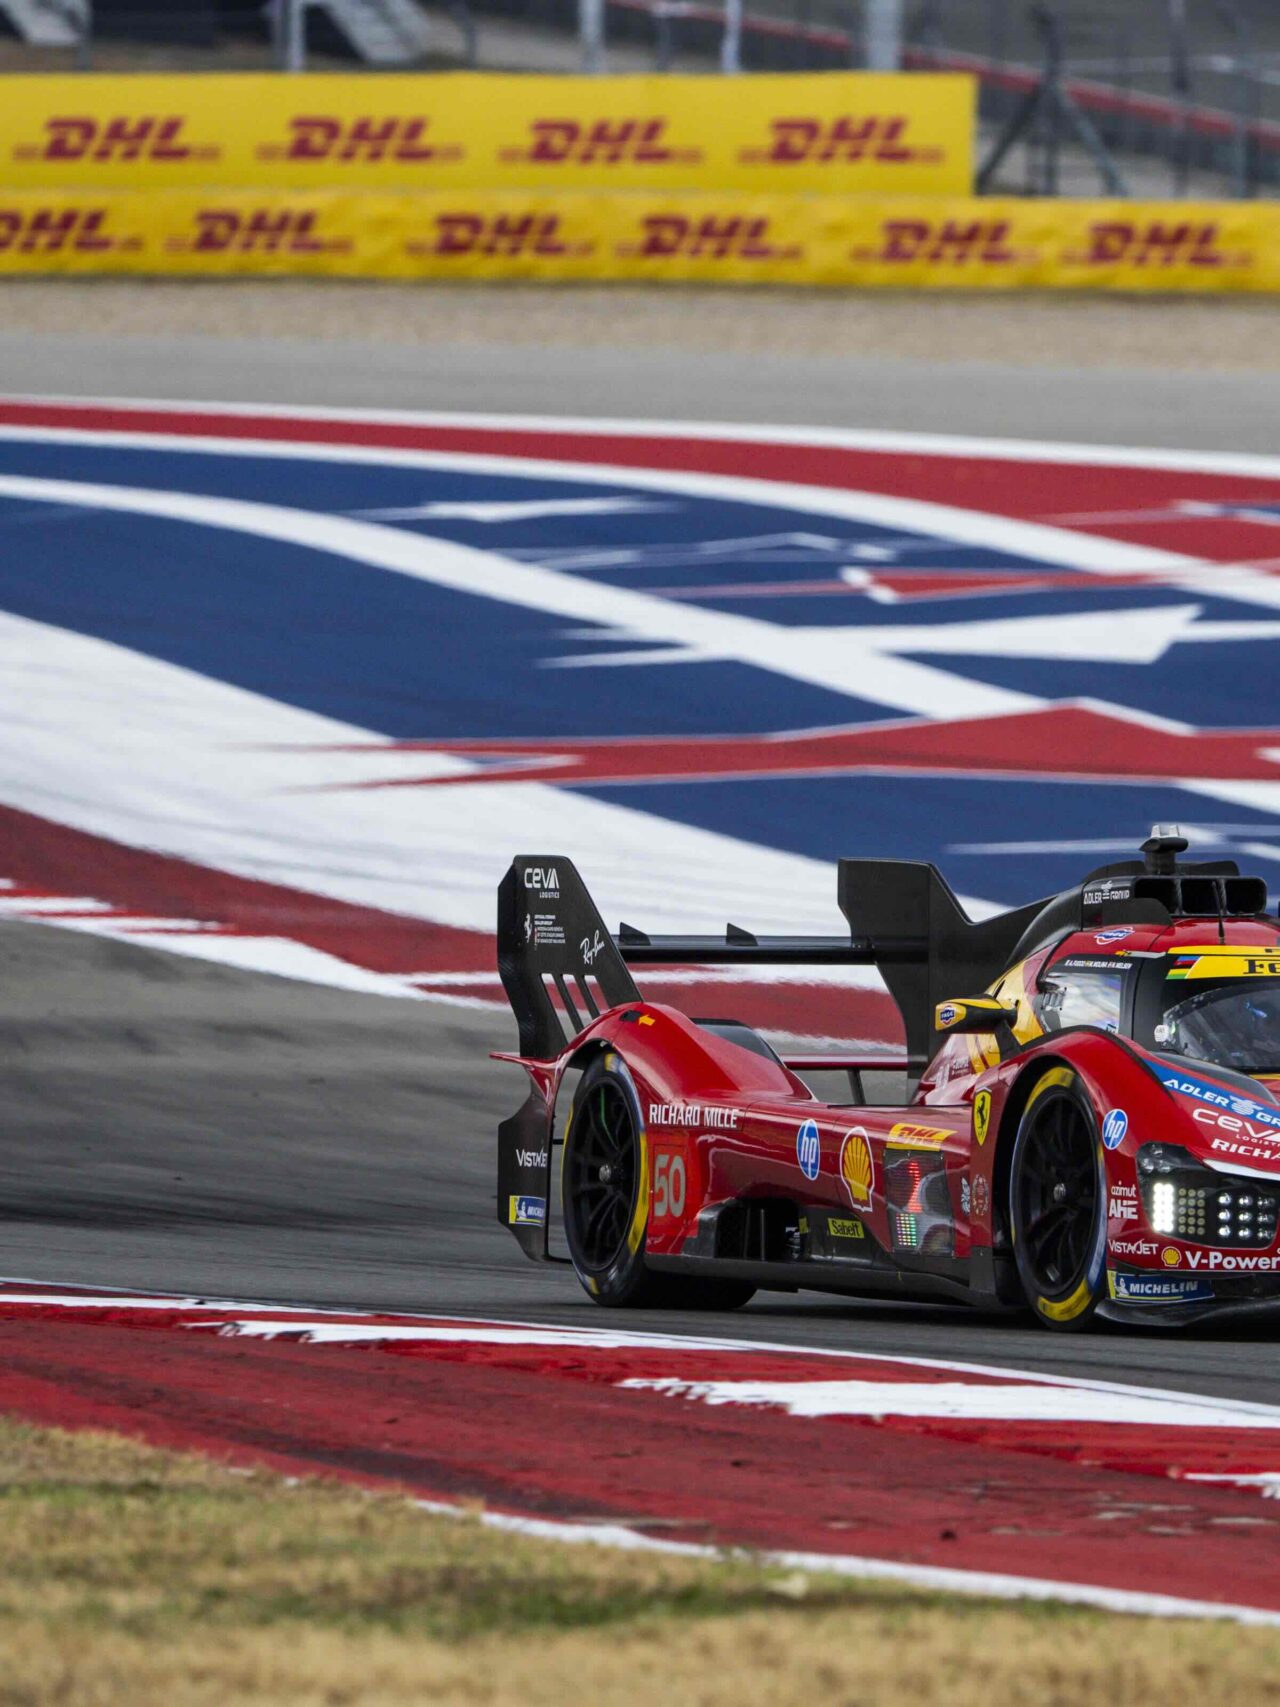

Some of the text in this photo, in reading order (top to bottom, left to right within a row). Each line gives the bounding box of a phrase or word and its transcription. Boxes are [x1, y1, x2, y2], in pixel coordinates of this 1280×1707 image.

[46, 117, 909, 164] DHL DHL DHL DHL
[194, 209, 322, 253] DHL
[434, 213, 565, 256] DHL
[642, 215, 772, 257] DHL
[882, 220, 1013, 264] DHL
[1089, 222, 1222, 267] DHL
[1163, 1078, 1229, 1107] ADLER
[649, 1103, 739, 1129] RICHARD MILLE
[1104, 1110, 1126, 1149] hp
[798, 1119, 819, 1180] hp
[654, 1153, 686, 1217] 50
[1111, 1180, 1137, 1198] azimut
[832, 1219, 862, 1237] Sabelt
[1129, 1280, 1199, 1294] MICHELIN
